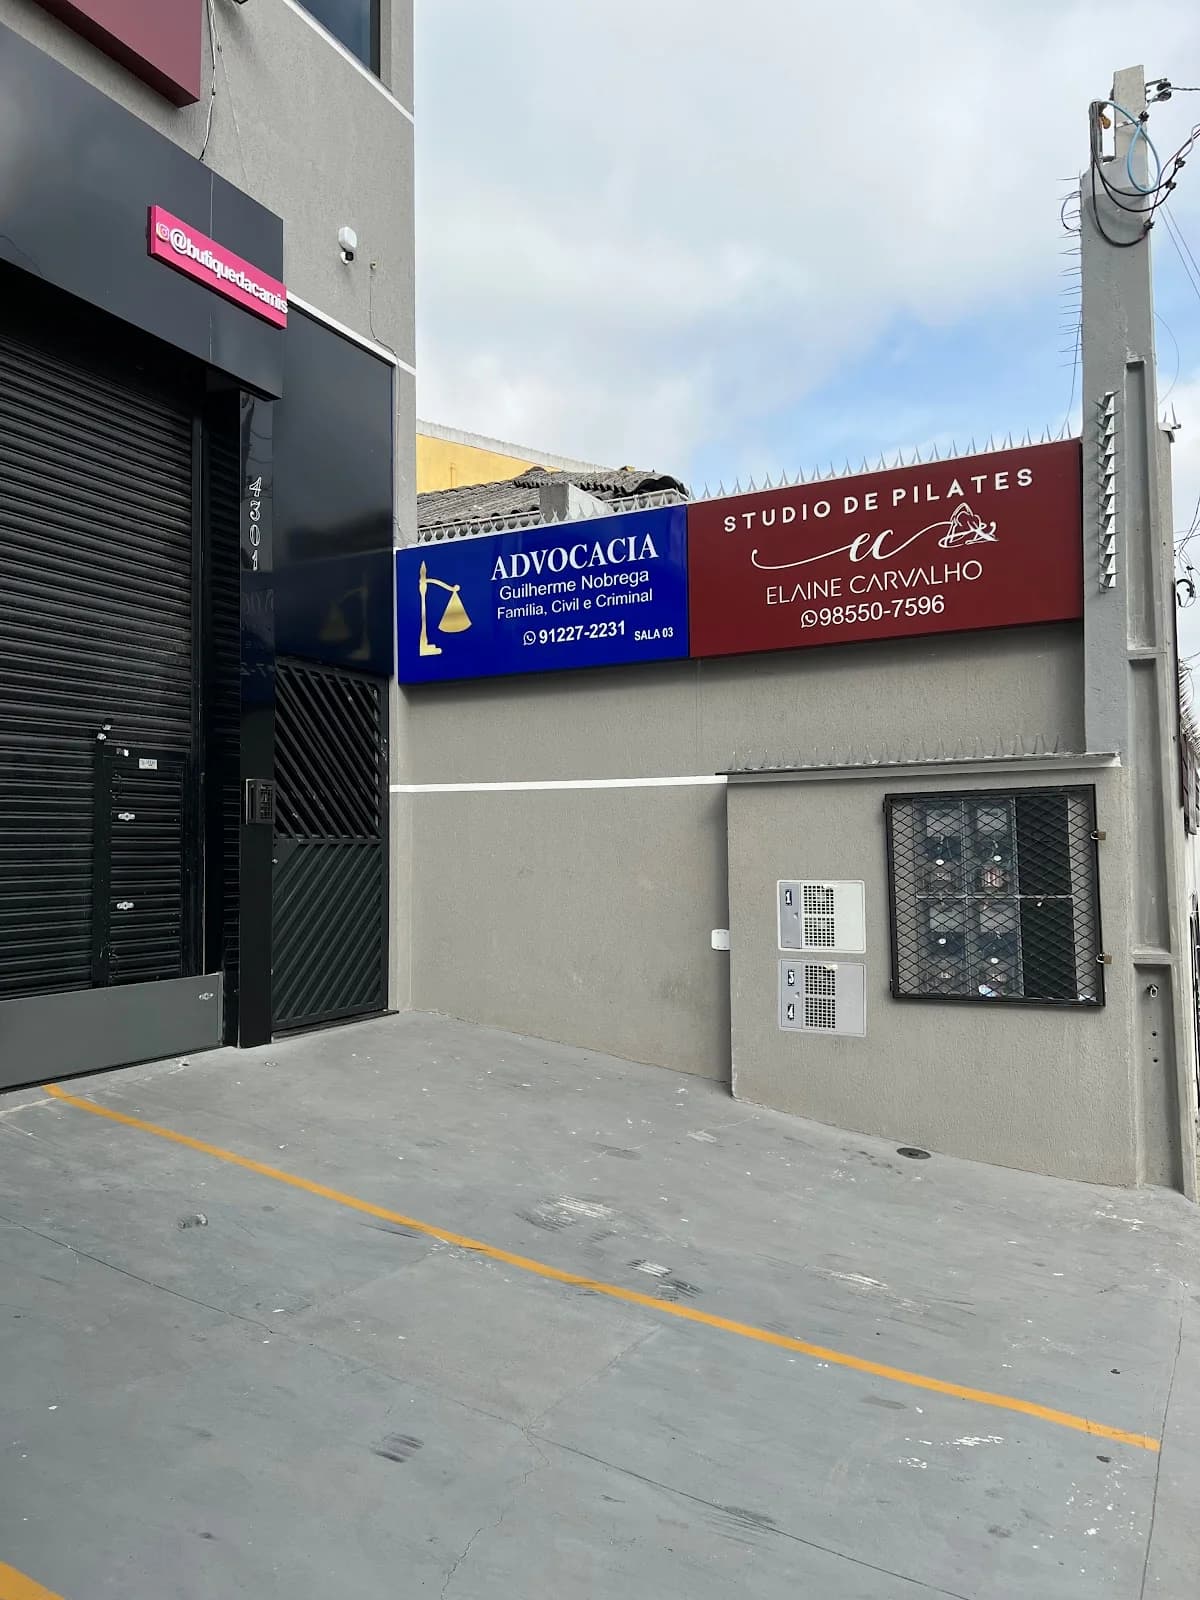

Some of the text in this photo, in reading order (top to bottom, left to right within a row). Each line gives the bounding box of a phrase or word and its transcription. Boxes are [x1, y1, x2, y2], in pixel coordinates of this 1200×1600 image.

[170, 228, 288, 314] @butiquedacamis
[723, 468, 1034, 533] STUDIO DE PILATES
[248, 476, 262, 572] 4301
[490, 533, 659, 581] ADVOCACIA
[499, 570, 650, 600] Guilherme Nobrega
[551, 598, 580, 614] Civil
[583, 600, 592, 610] e
[595, 588, 653, 608] Criminal
[766, 559, 983, 605] ELAINE CARVALHO
[539, 620, 674, 645] 91227-2231 SALA 03
[819, 594, 945, 626] 98550-7596
